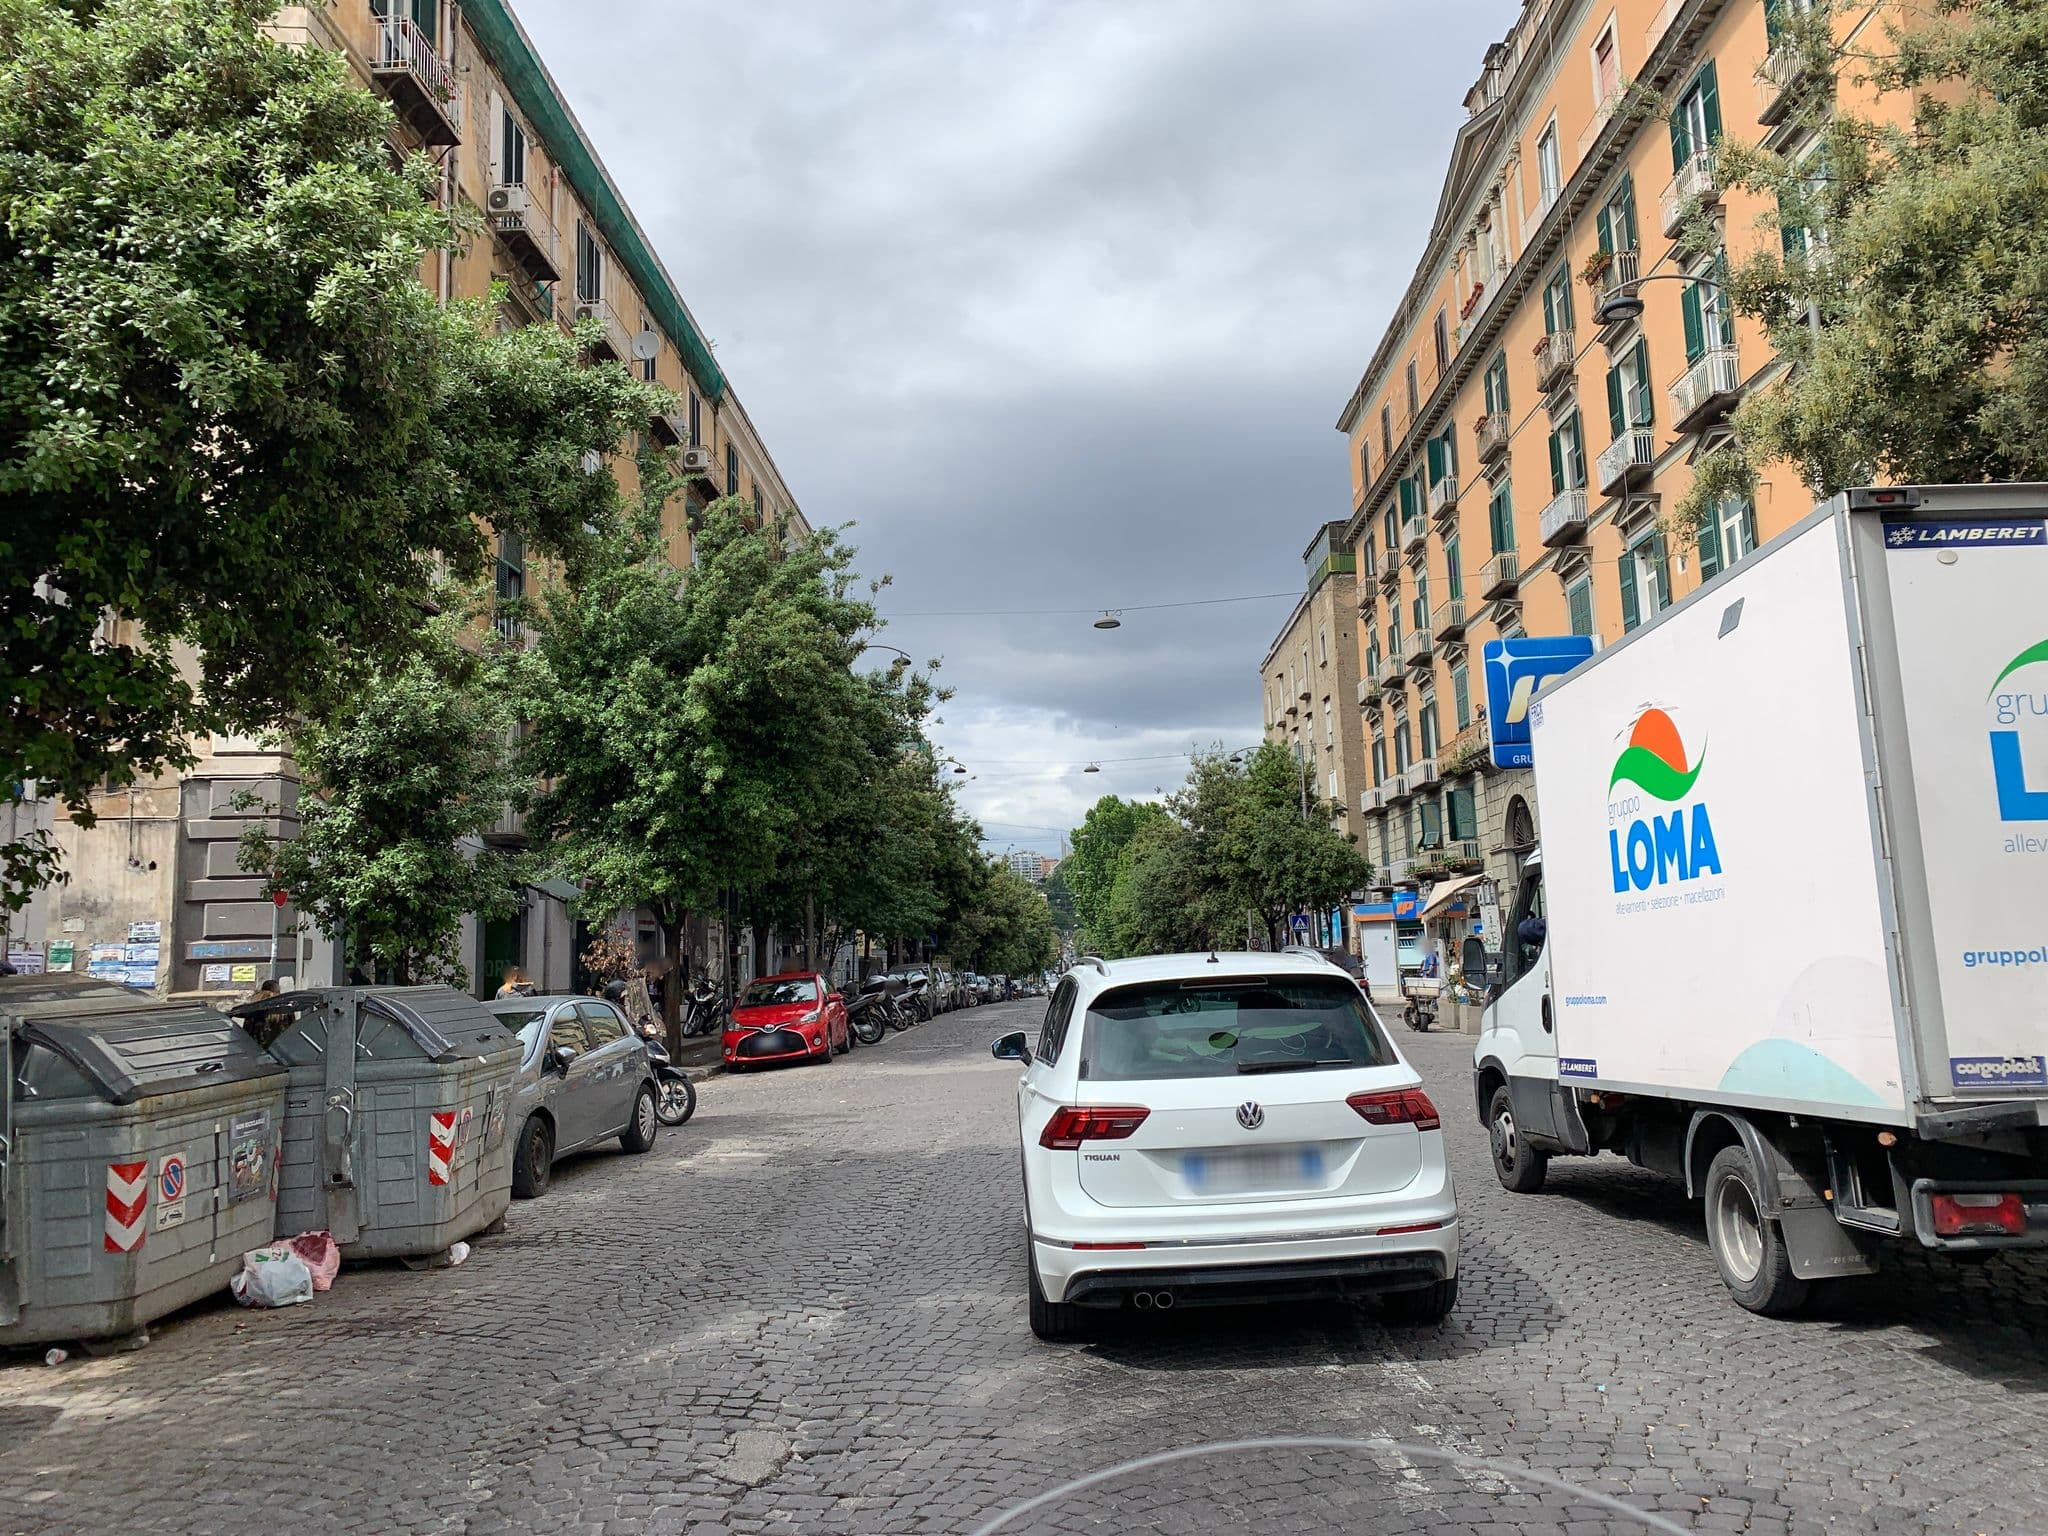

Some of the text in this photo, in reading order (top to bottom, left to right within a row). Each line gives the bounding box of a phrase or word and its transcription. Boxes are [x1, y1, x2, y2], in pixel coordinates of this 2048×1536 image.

[1918, 526, 2044, 541] LAMBERET
[1608, 794, 1640, 826] gruppo
[1608, 802, 1723, 894] LOMA
[1566, 1062, 1596, 1073] LAMBERET
[1083, 1153, 1121, 1162] TIGUAN
